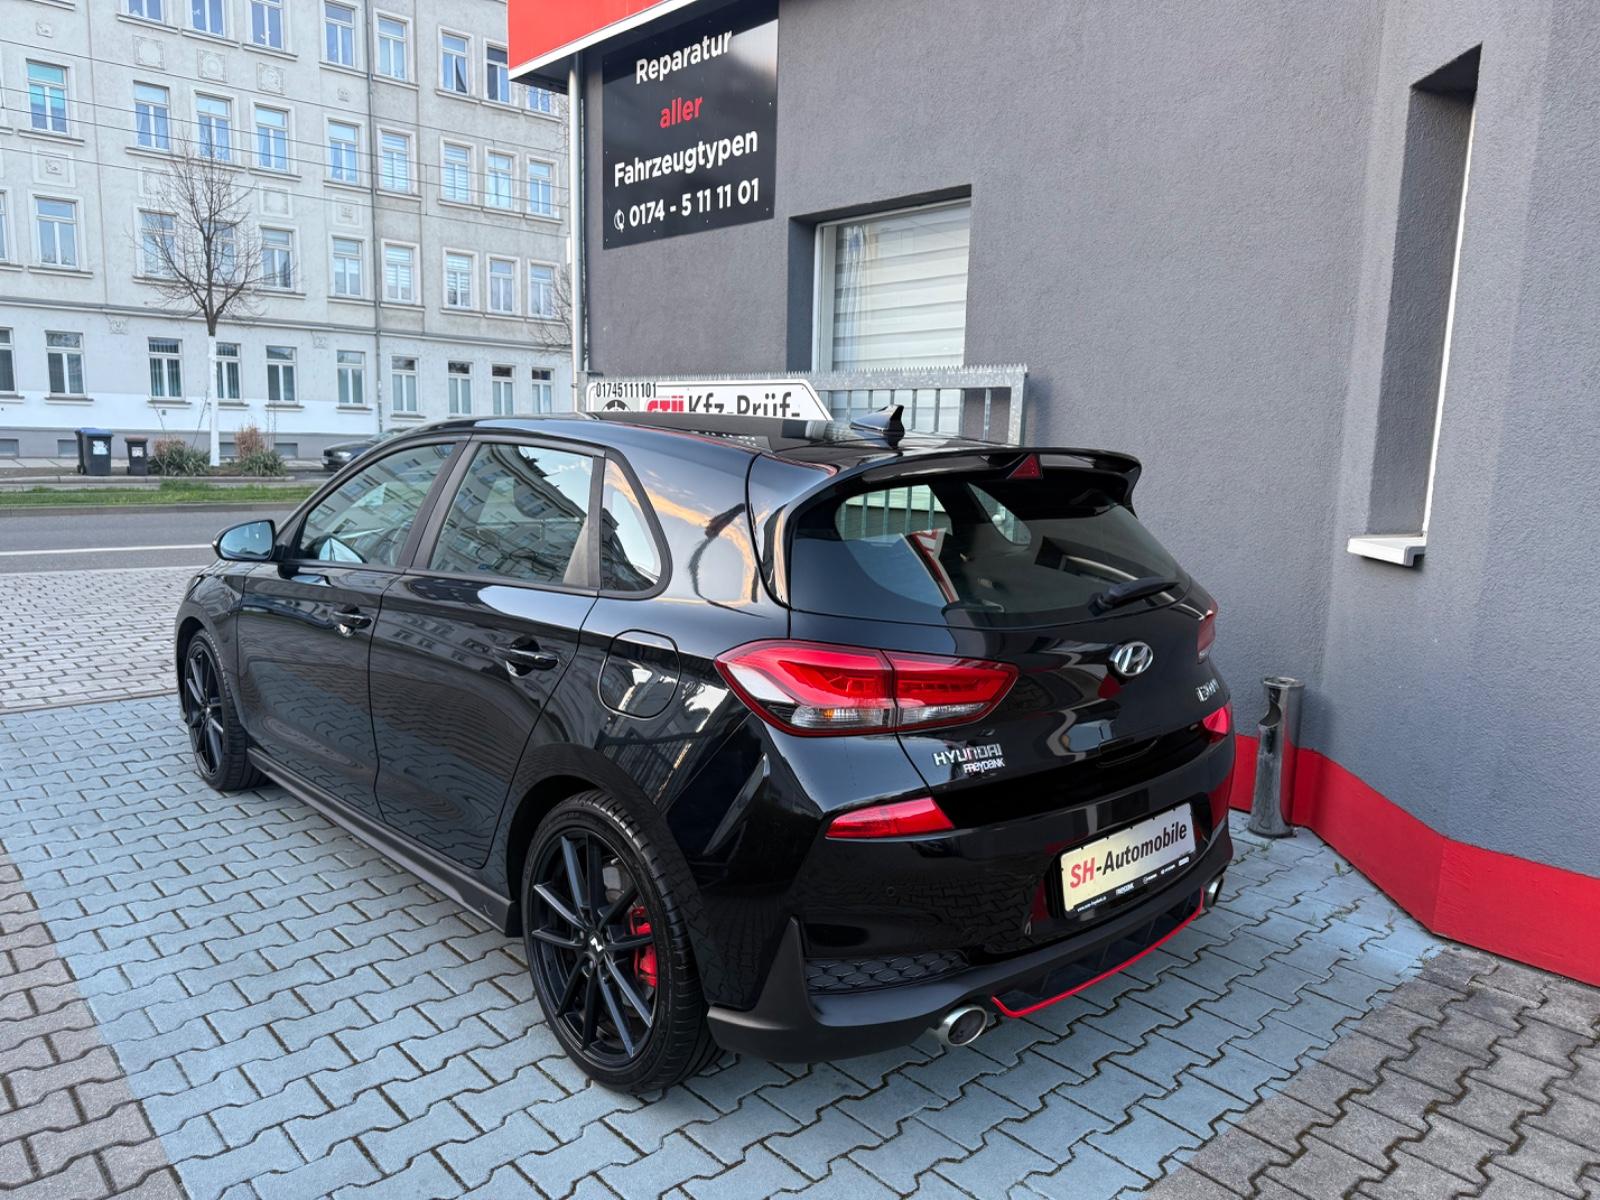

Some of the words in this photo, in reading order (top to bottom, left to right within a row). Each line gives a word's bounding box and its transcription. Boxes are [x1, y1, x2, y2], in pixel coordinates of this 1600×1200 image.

[635, 30, 733, 84] Reparatur
[660, 97, 703, 129] aller
[614, 129, 758, 187] Fahrzeugtypen
[629, 199, 665, 227] 0174
[681, 193, 692, 217] 5
[738, 178, 759, 204] 01
[596, 382, 657, 398] 01745111101
[933, 743, 1003, 766] HYUNDAI
[1070, 821, 1188, 889] SH-Automobile
